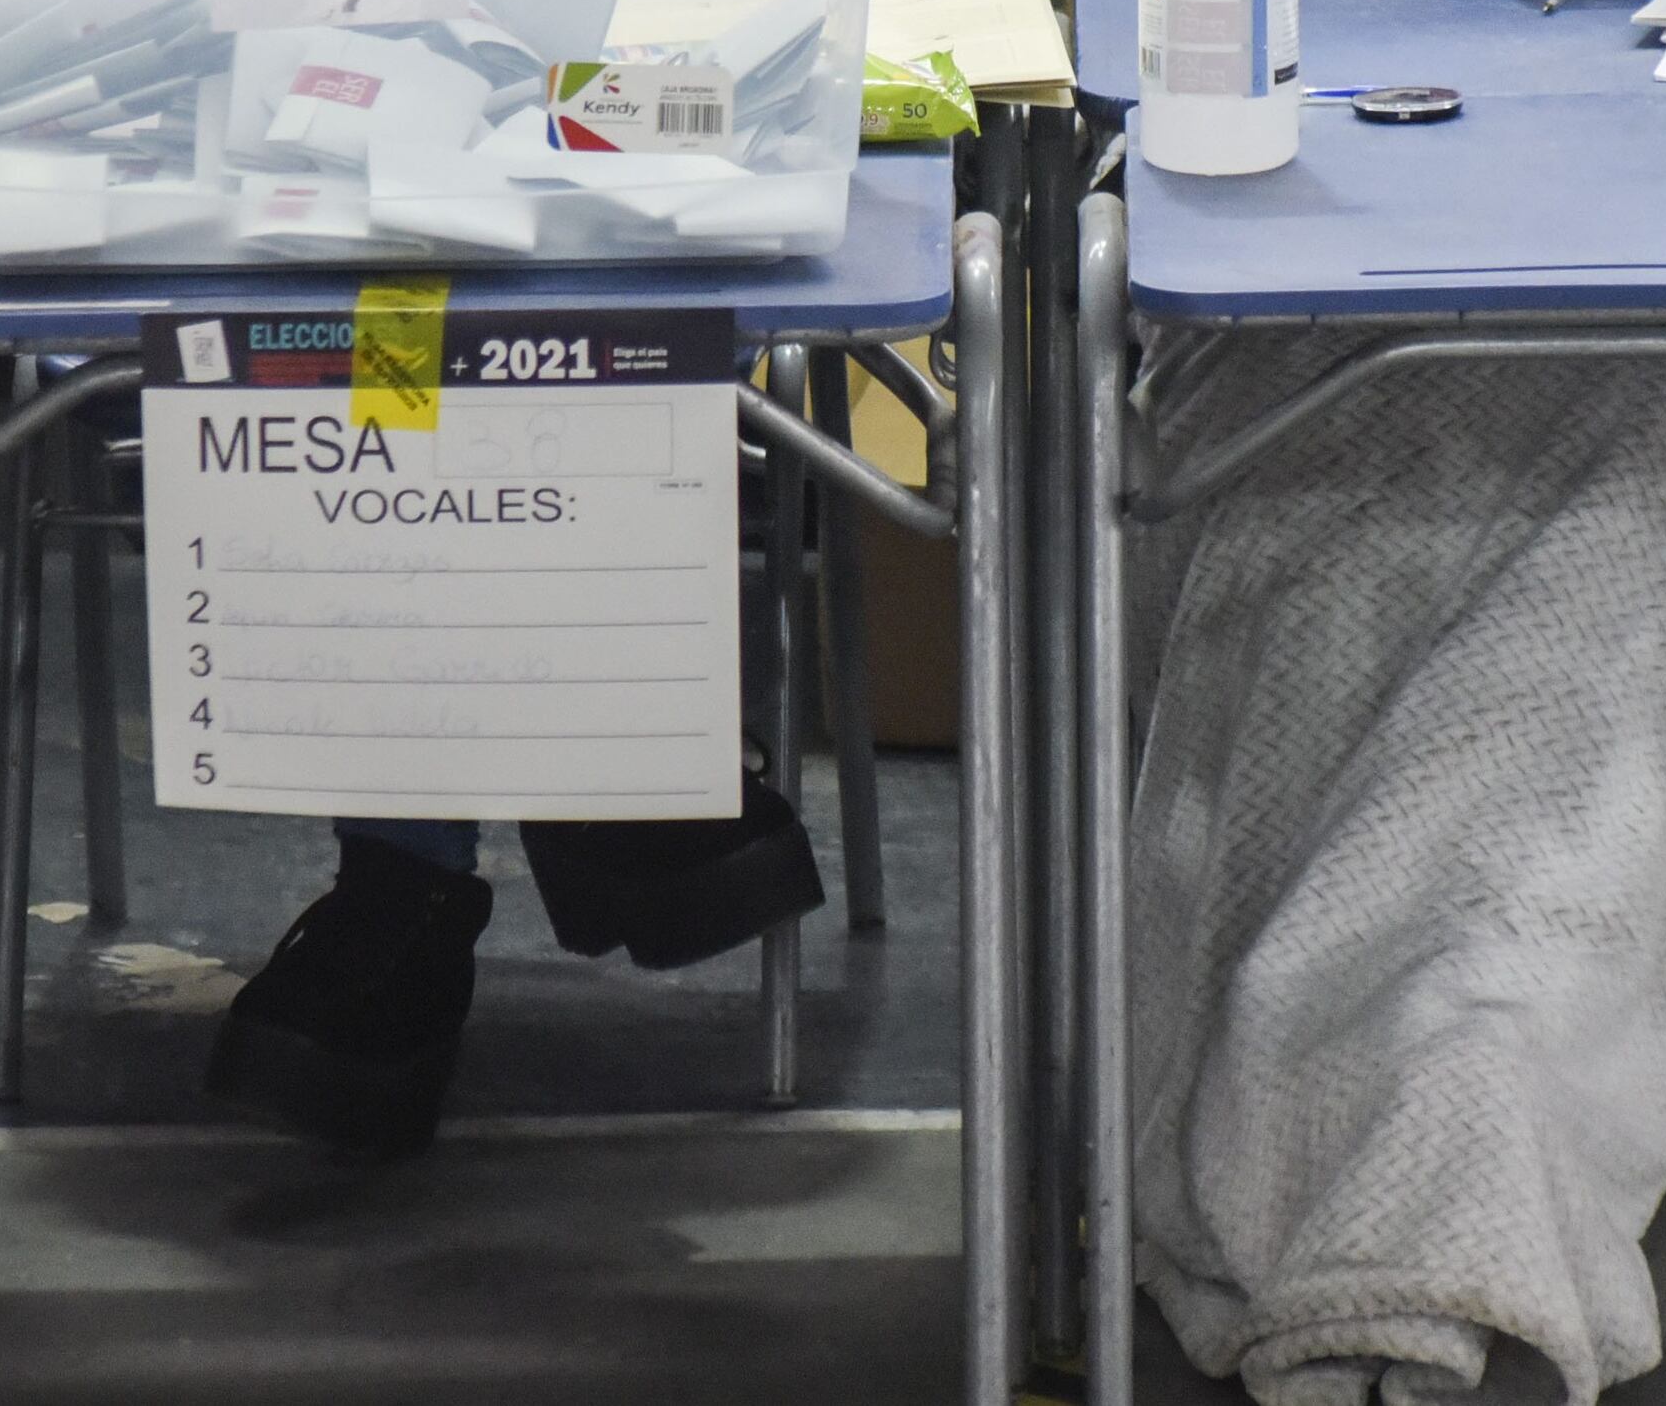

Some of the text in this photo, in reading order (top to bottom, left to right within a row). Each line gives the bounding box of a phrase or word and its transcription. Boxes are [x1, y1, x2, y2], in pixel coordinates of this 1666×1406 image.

[583, 100, 641, 116] Kendy
[902, 102, 928, 119] 50
[248, 322, 354, 351] ELECCIO
[480, 338, 597, 381] 2021
[199, 416, 396, 474] MESA
[313, 487, 577, 525] VOCALES:
[187, 537, 204, 570] 1
[186, 590, 211, 624] 2
[188, 644, 213, 678] 3
[189, 697, 214, 730] 4
[193, 752, 217, 786] 5
